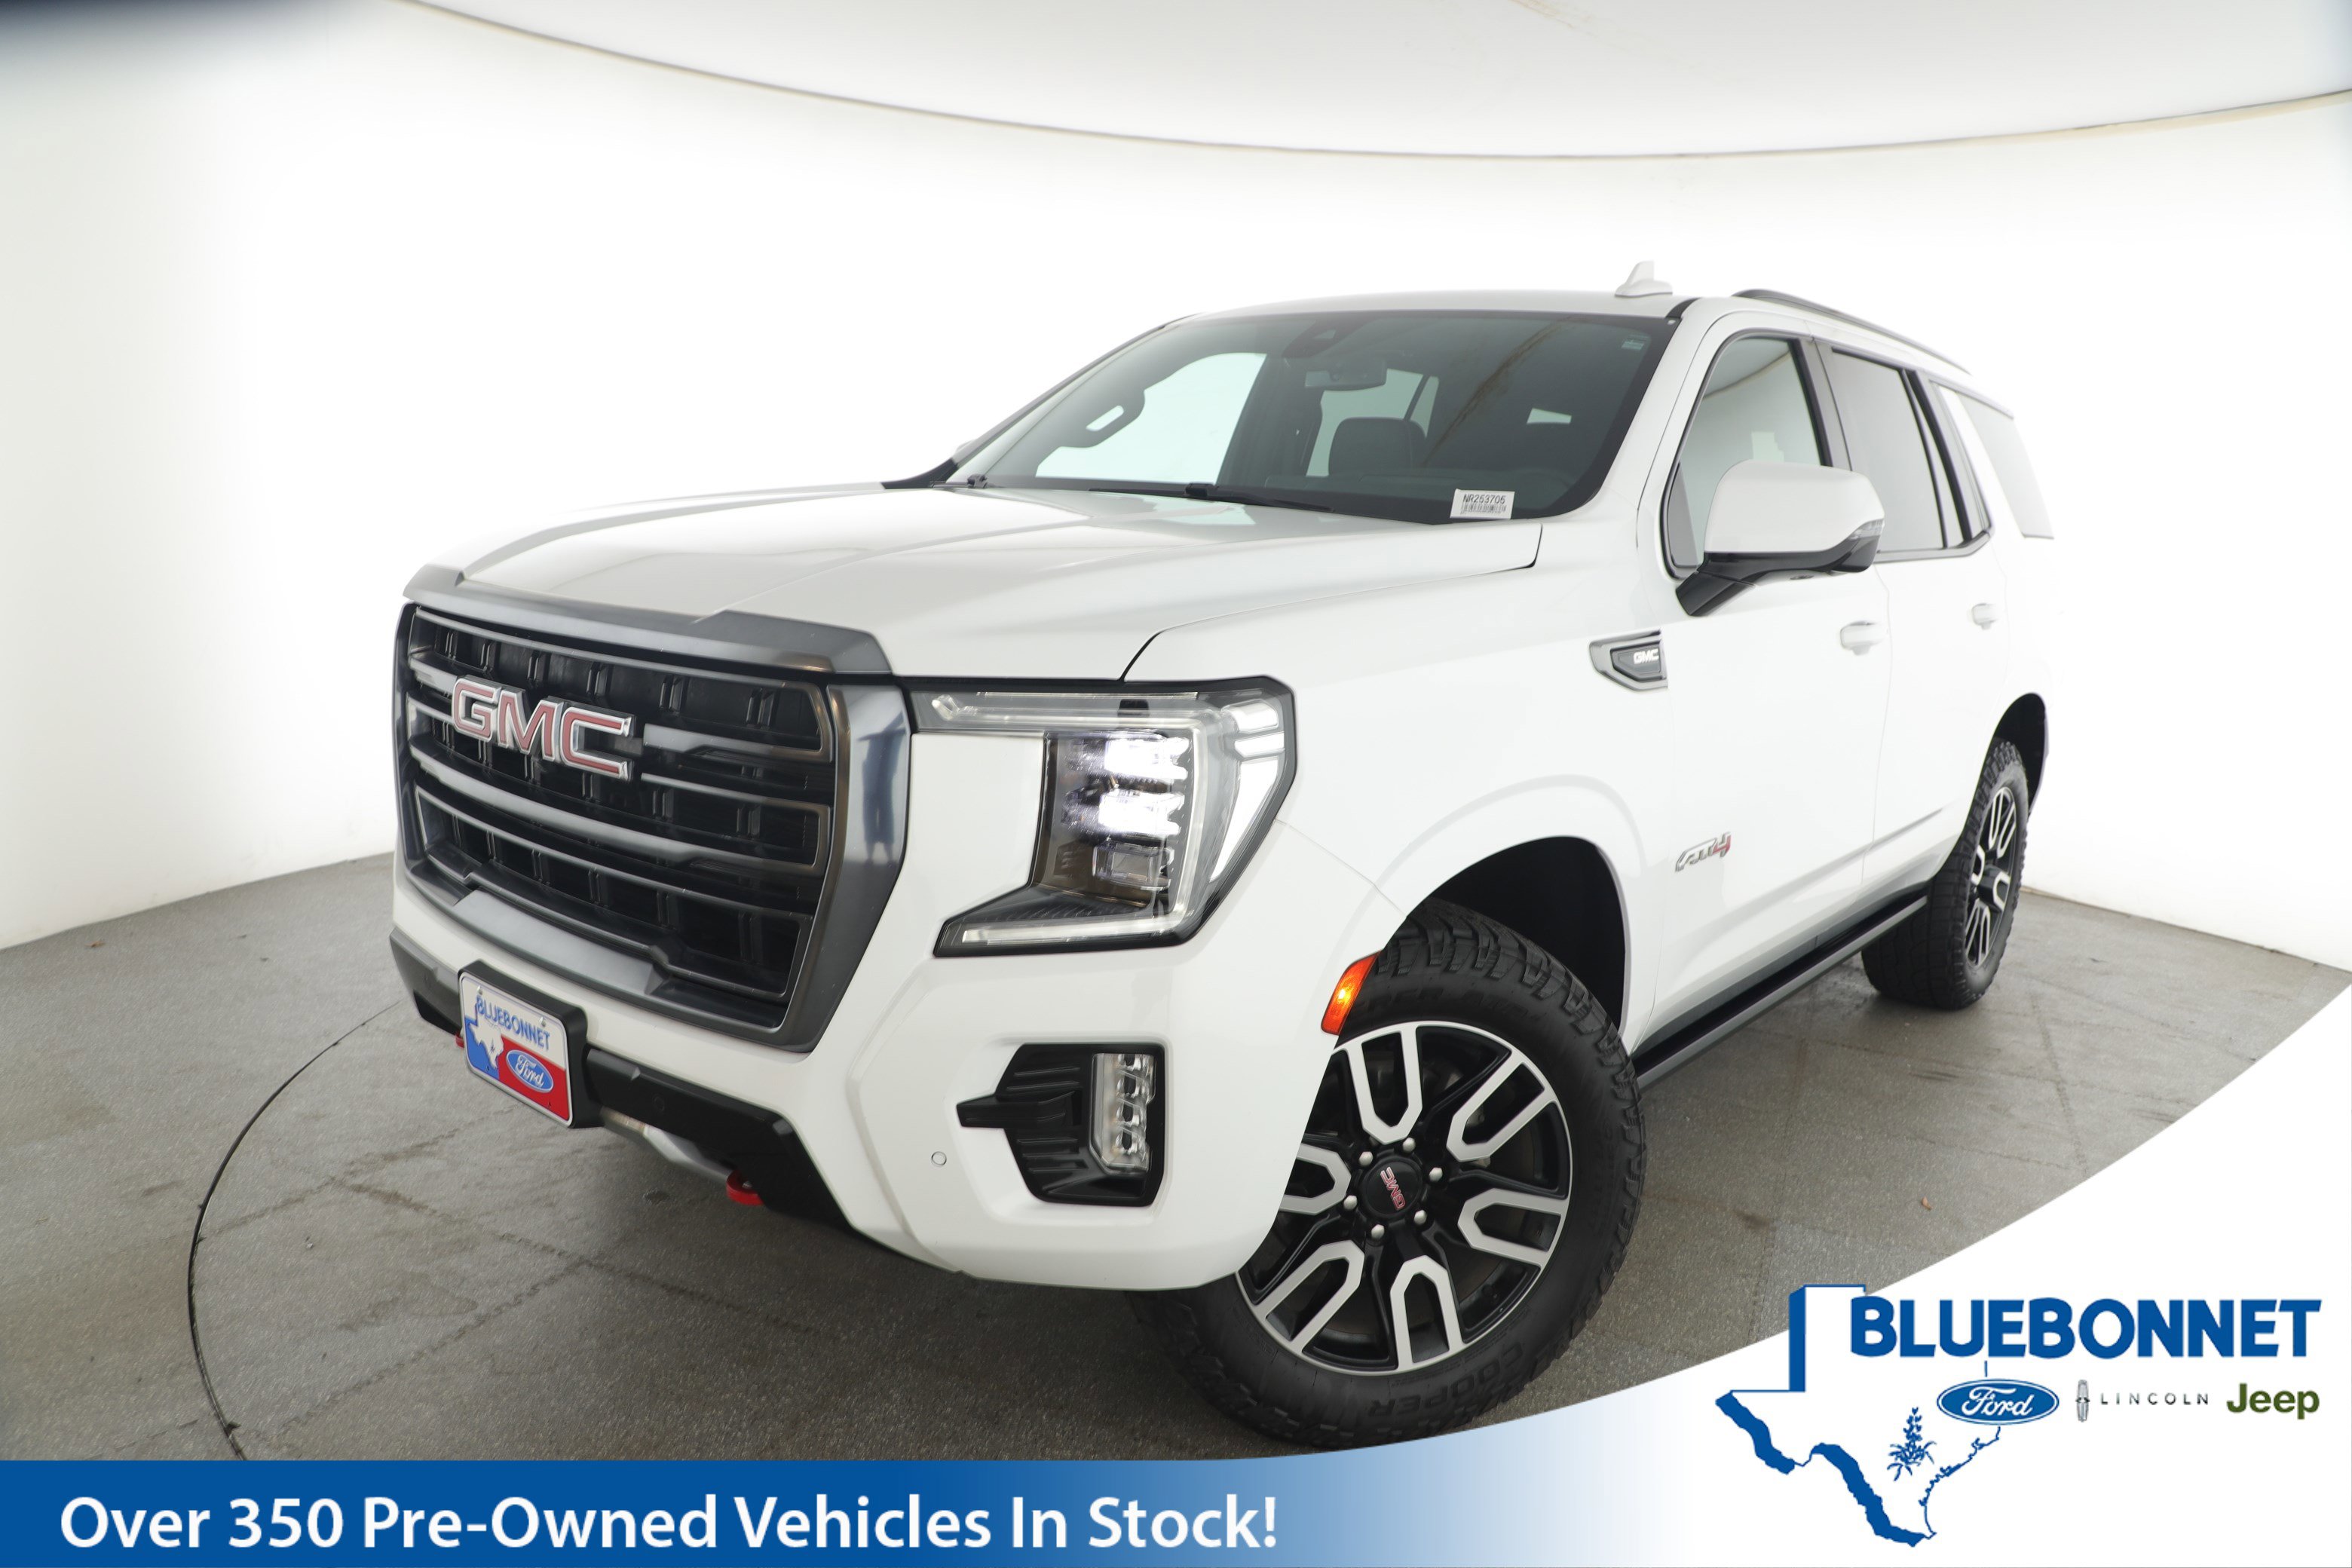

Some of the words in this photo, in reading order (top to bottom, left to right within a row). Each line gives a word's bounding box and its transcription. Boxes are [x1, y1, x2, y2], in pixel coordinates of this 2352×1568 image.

[1633, 648, 1659, 664] GMC
[452, 675, 635, 782] GMC
[476, 994, 551, 1051] BLUEBONNET
[514, 1054, 544, 1088] Ford
[1380, 1166, 1406, 1211] GMC
